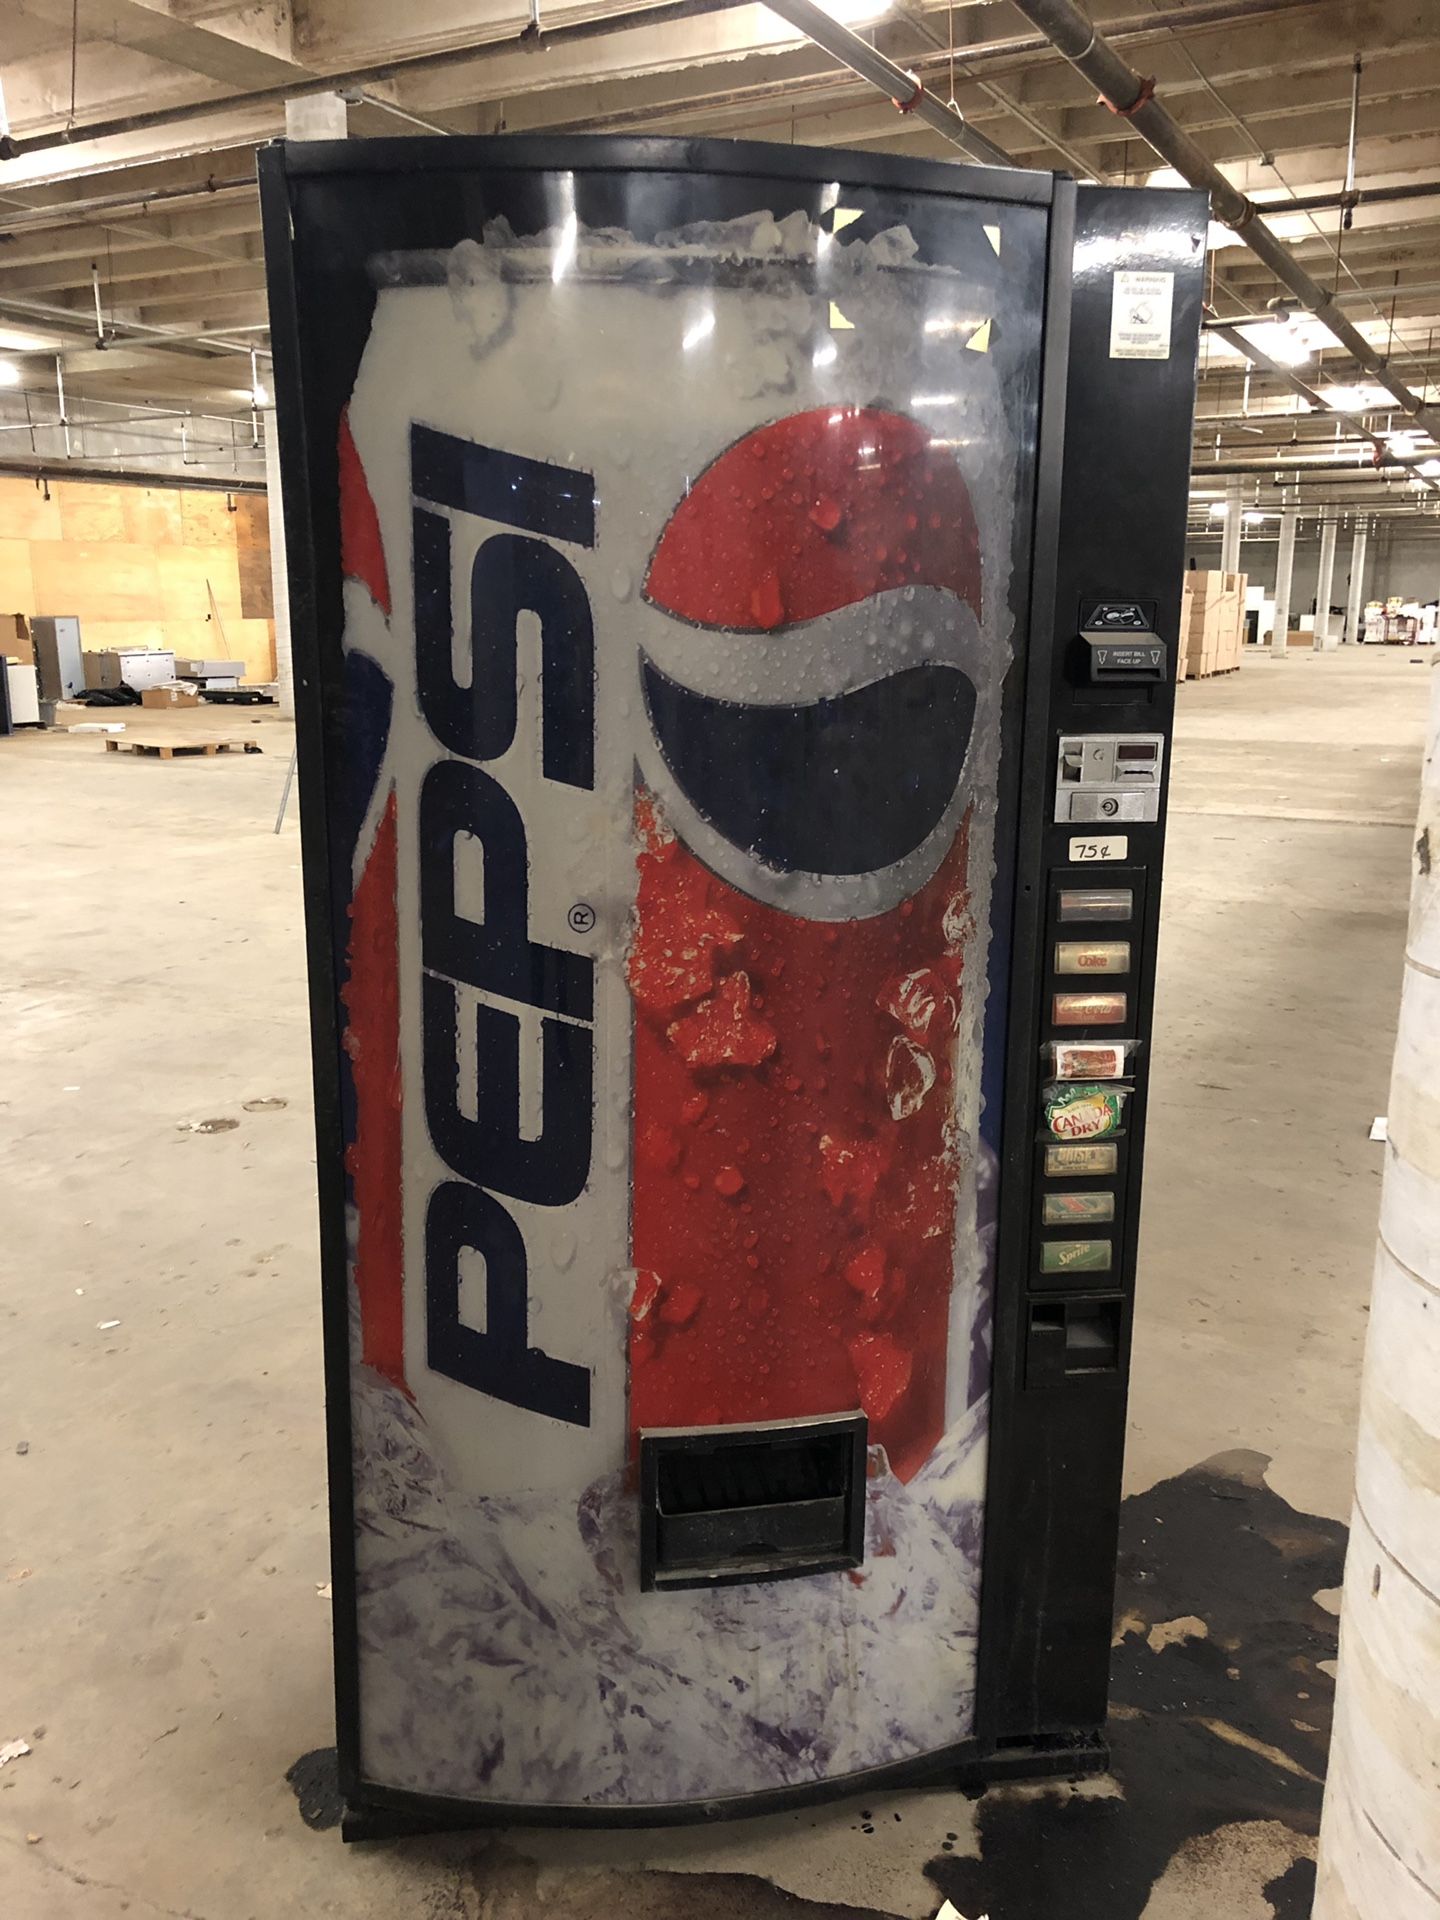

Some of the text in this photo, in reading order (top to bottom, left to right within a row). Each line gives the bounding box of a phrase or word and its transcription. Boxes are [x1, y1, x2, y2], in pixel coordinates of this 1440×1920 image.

[410, 420, 596, 1428] PEPSI
[1078, 955, 1107, 967] Coke
[1053, 1103, 1113, 1133] CANDA
[1071, 1119, 1100, 1136] DRY
[1058, 1243, 1090, 1265] Sprite
